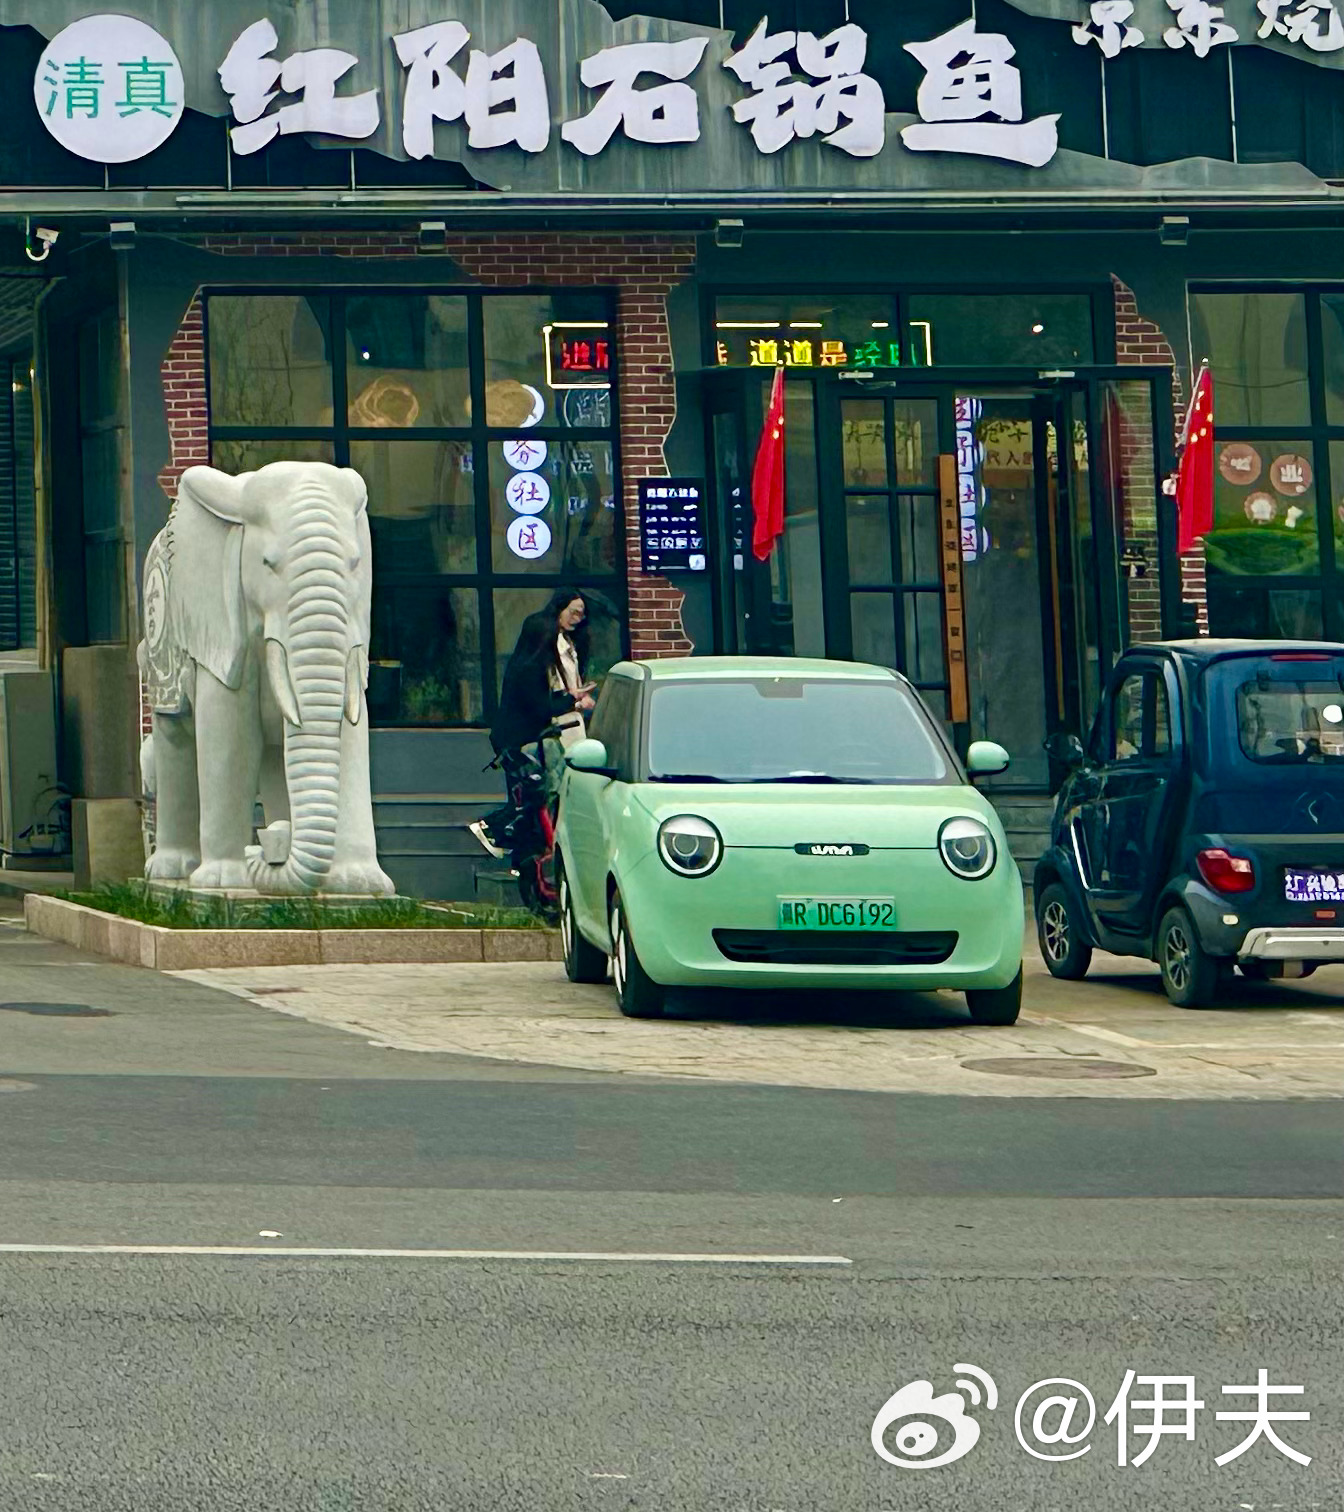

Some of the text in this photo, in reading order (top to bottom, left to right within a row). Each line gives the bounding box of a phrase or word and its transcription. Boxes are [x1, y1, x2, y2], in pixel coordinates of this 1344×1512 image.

[44, 55, 177, 120] 清真
[217, 15, 1063, 168] 红阳石锅鱼
